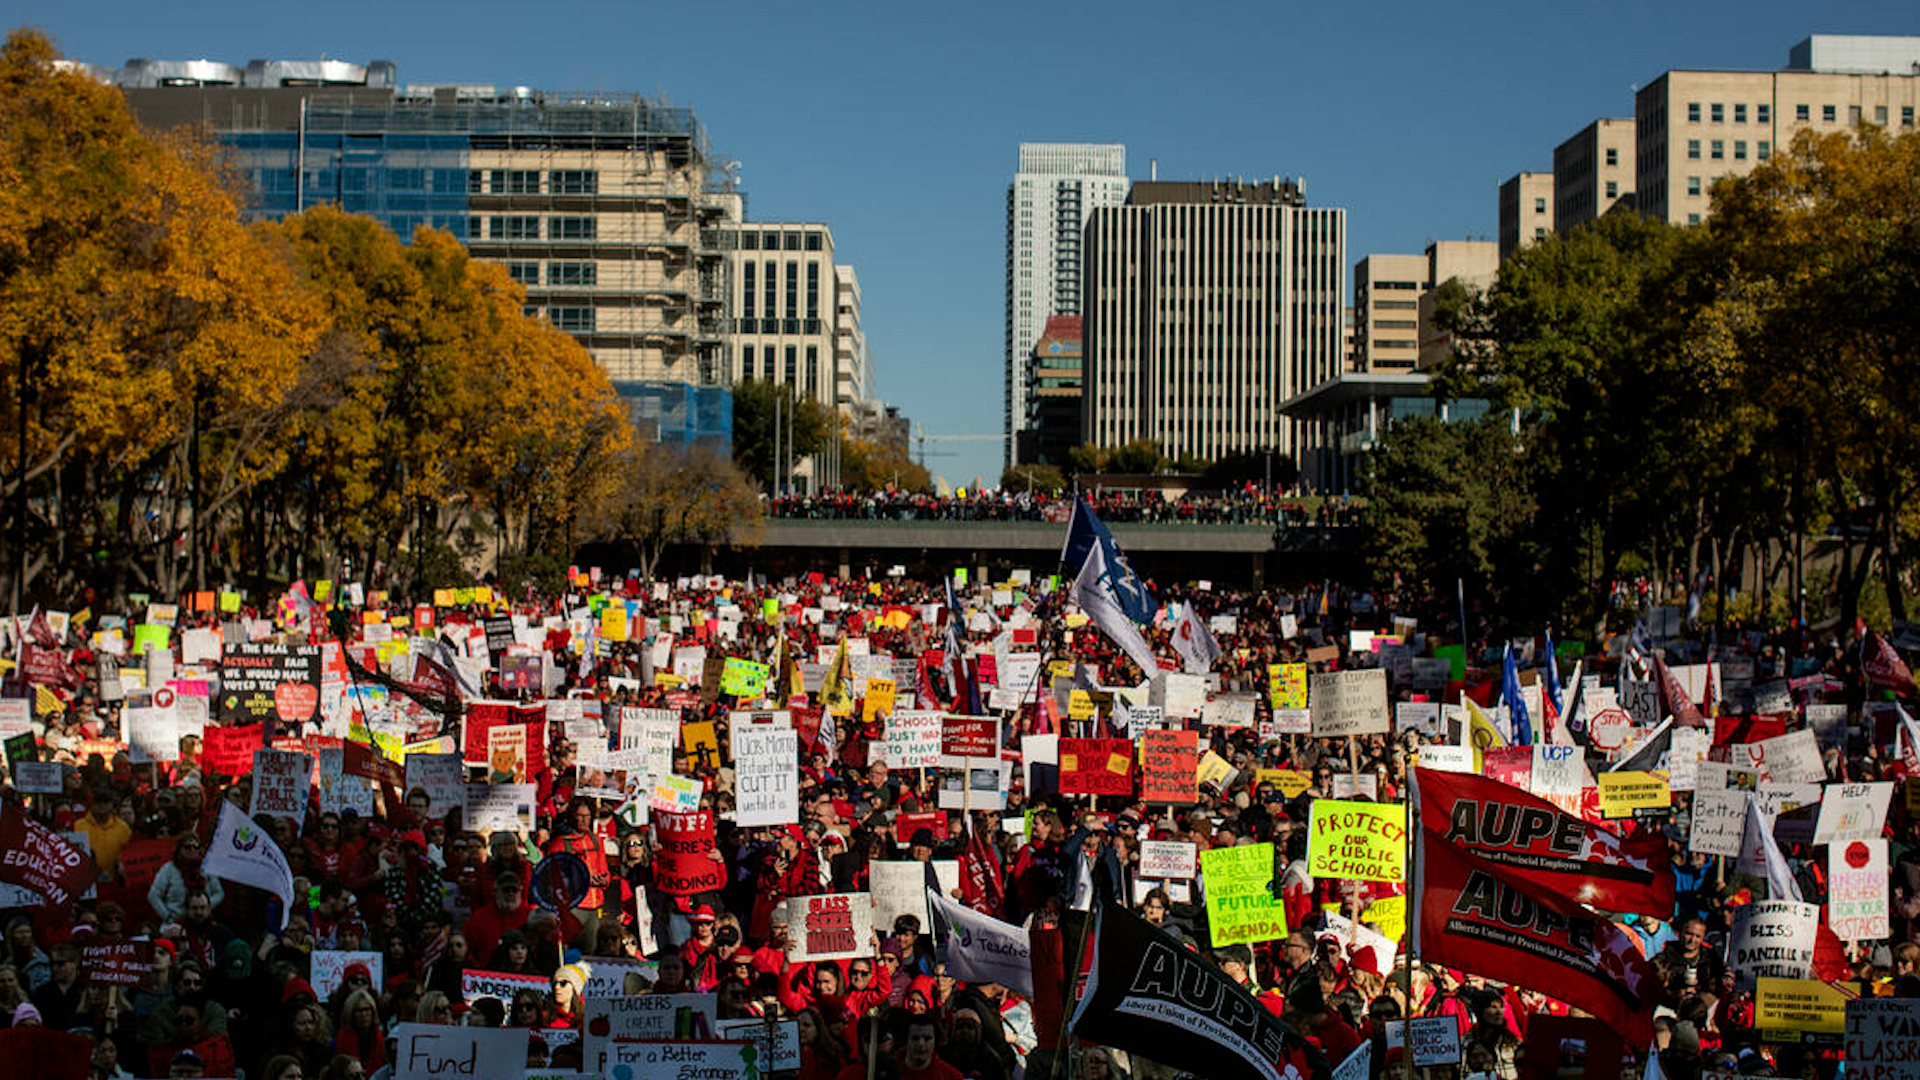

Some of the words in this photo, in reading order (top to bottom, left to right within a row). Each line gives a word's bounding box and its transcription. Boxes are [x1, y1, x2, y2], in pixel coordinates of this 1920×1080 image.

[225, 643, 236, 654] IF
[242, 643, 260, 654] THE
[262, 644, 288, 654] DEAL
[296, 646, 319, 655] WAS
[223, 657, 274, 668] ACTUALLY
[284, 657, 308, 668] FAIR
[223, 669, 241, 680] WE
[245, 669, 280, 680] WOULD
[282, 670, 309, 680] HAVE
[223, 681, 257, 691] VOTED
[260, 681, 277, 691] YES
[1625, 693, 1656, 713] LAST
[888, 732, 916, 742] JUST
[888, 745, 902, 755] TO
[1542, 746, 1573, 761] UCP
[741, 774, 772, 793] CUT
[774, 774, 788, 793] IT
[1842, 785, 1871, 798] HELP!
[1695, 800, 1744, 819] Better
[657, 813, 708, 832] WTF?
[1317, 812, 1406, 842] PROTECT
[1446, 798, 1588, 855] AUPE
[1344, 834, 1369, 845] OUR
[1329, 844, 1394, 863] PUBLIC
[1316, 854, 1401, 880] SCHOOLS
[809, 896, 850, 913] CLASS
[1218, 895, 1280, 911] FUTURE
[1217, 922, 1282, 940] AGENDA
[1449, 919, 1481, 935] Alberta
[1482, 924, 1507, 942] Union
[1508, 933, 1517, 945] of
[1517, 936, 1557, 957] Provincial
[1750, 925, 1794, 937] BLISS
[610, 997, 672, 1012] TEACHERS
[1130, 941, 1285, 1065] AUPE
[1158, 1003, 1186, 1020] Union
[1199, 1018, 1241, 1049] Provincial
[1850, 1015, 1867, 1035] I
[408, 1033, 478, 1075] Fund
[617, 1046, 642, 1063] For
[646, 1052, 657, 1063] a
